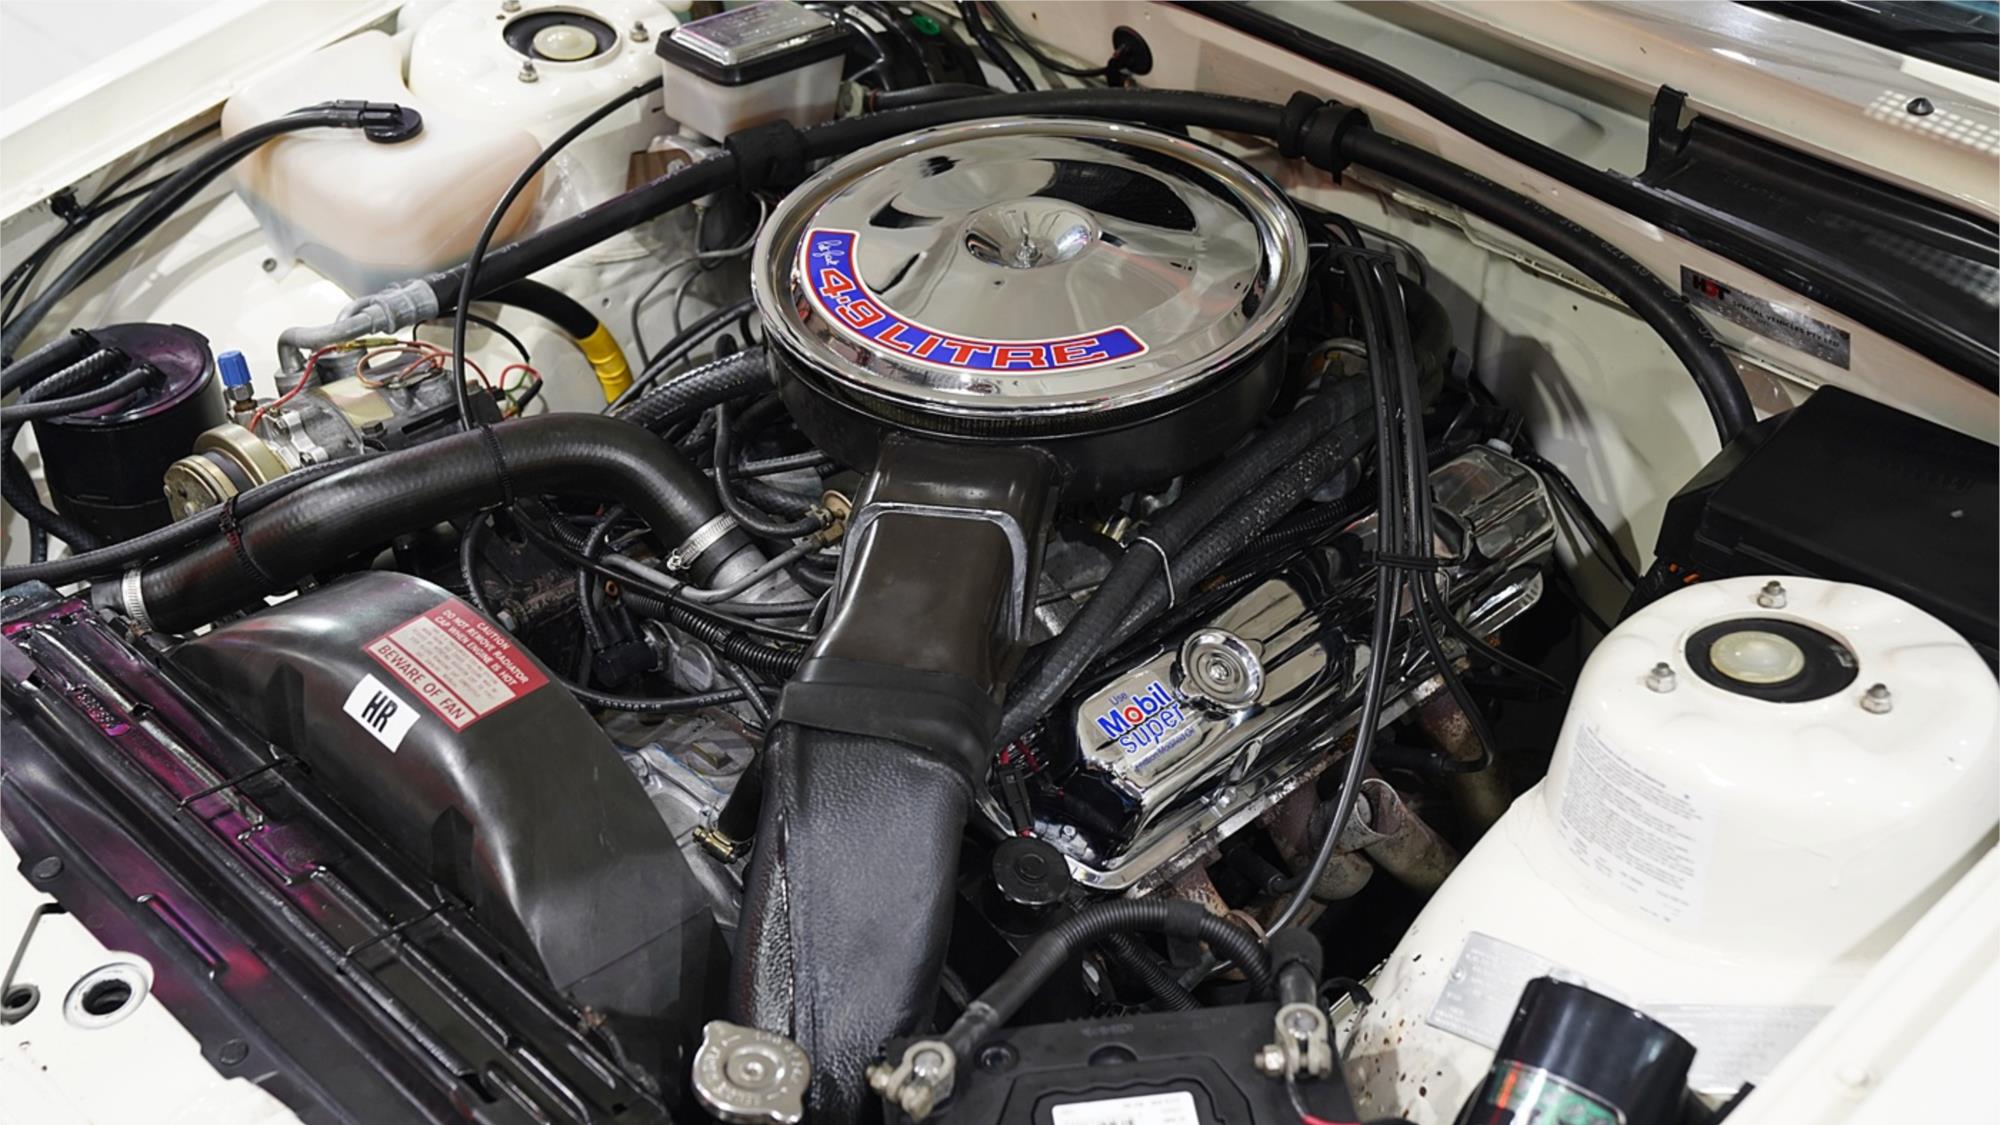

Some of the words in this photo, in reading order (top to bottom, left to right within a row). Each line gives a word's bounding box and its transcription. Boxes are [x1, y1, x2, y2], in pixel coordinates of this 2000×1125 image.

[877, 323, 1109, 369] LITRE
[434, 616, 451, 627] CAP
[448, 625, 471, 644] WHEN
[467, 641, 494, 665] ENGINE
[491, 663, 502, 673] IS
[499, 671, 518, 686] HOT
[442, 609, 456, 620] DO
[452, 617, 470, 629] NOT
[466, 628, 496, 652] REMOVE
[492, 650, 529, 684] RADIATOR
[477, 622, 511, 650] CAUTION
[377, 643, 426, 684] BEWARE
[423, 682, 443, 698] OF
[439, 697, 466, 720] FAN
[1108, 692, 1128, 706] Use
[361, 690, 398, 733] HR
[1096, 681, 1174, 738] Mobil
[1119, 702, 1185, 754] super
